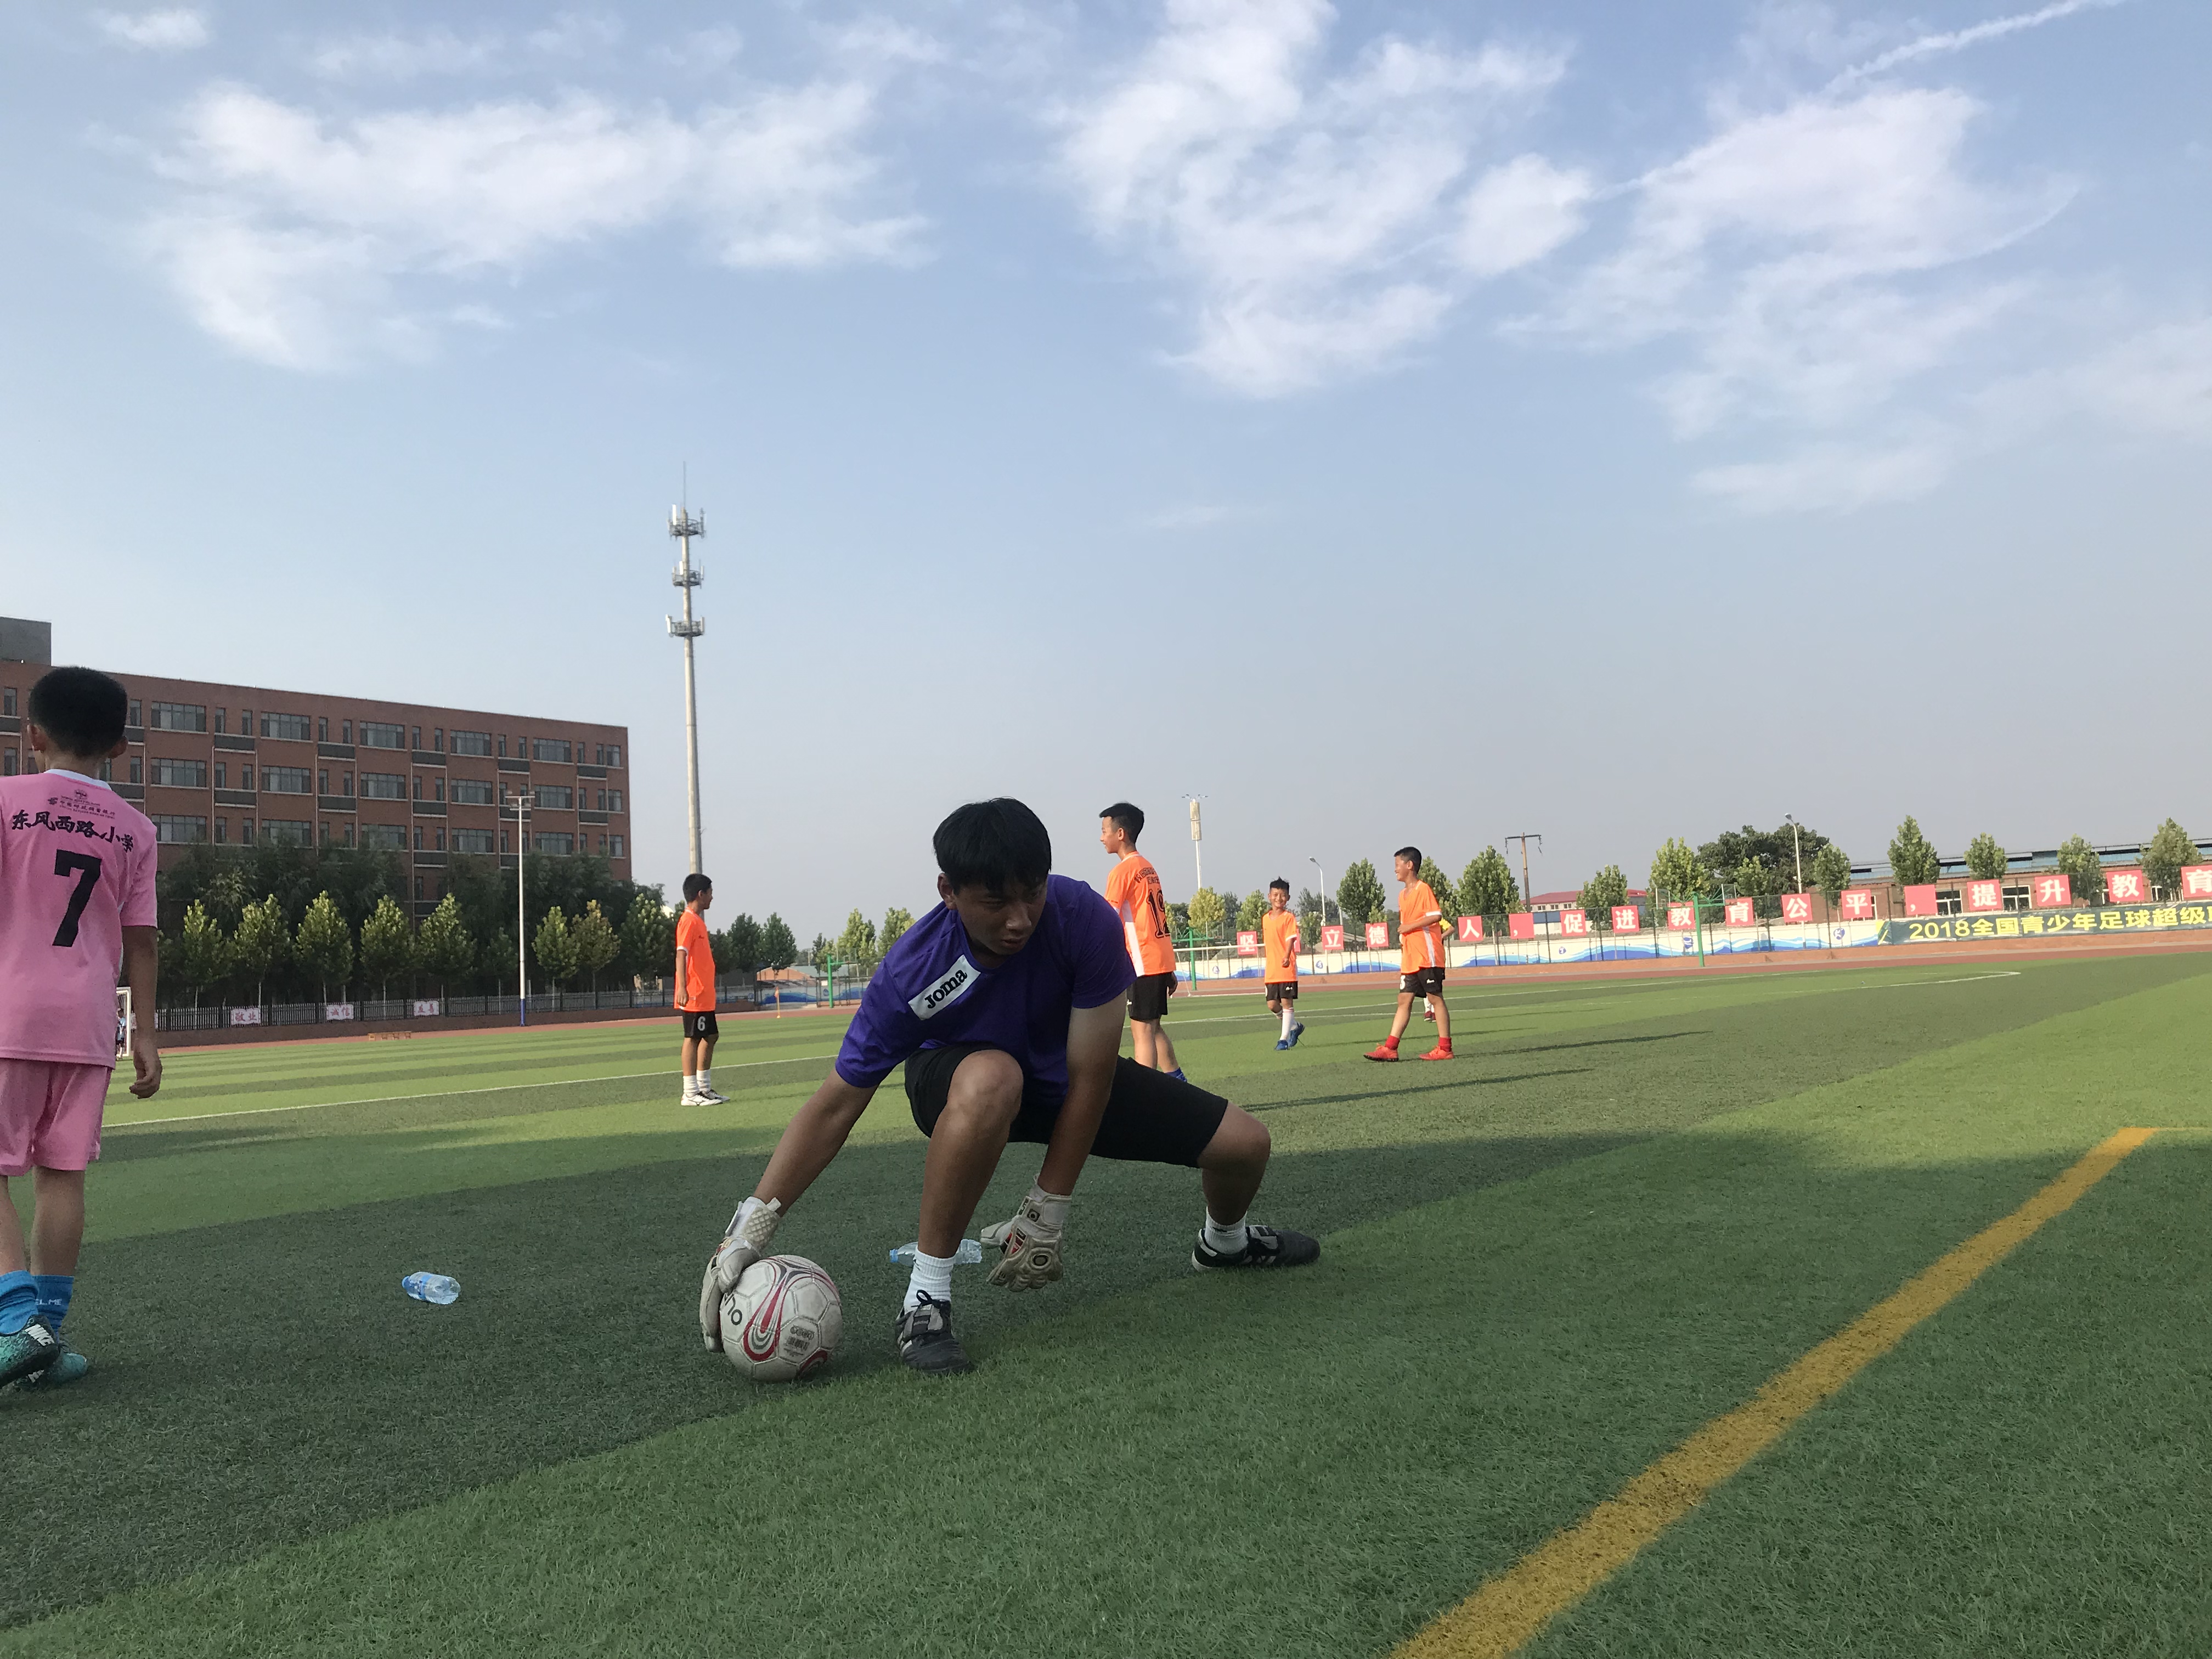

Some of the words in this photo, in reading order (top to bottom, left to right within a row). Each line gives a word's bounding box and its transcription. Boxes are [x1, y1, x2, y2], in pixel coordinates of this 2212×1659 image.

[12, 809, 134, 853] 东风西路小学
[52, 849, 102, 947] 7
[1324, 928, 1341, 947] 立
[1368, 926, 1386, 945] 德
[1462, 919, 1481, 939] 人
[1563, 913, 1583, 934] 促
[1615, 909, 1636, 930] 进
[1671, 906, 1692, 927] 教
[1728, 902, 1750, 924] 育
[1785, 897, 1808, 919] 公
[1845, 893, 1868, 915] 平
[1971, 883, 1998, 907] 提
[2039, 878, 2066, 903] 升
[2112, 874, 2140, 898] 教
[2185, 868, 2212, 894] 育
[697, 1015, 706, 1031] 6
[25, 1323, 55, 1347] NIKE
